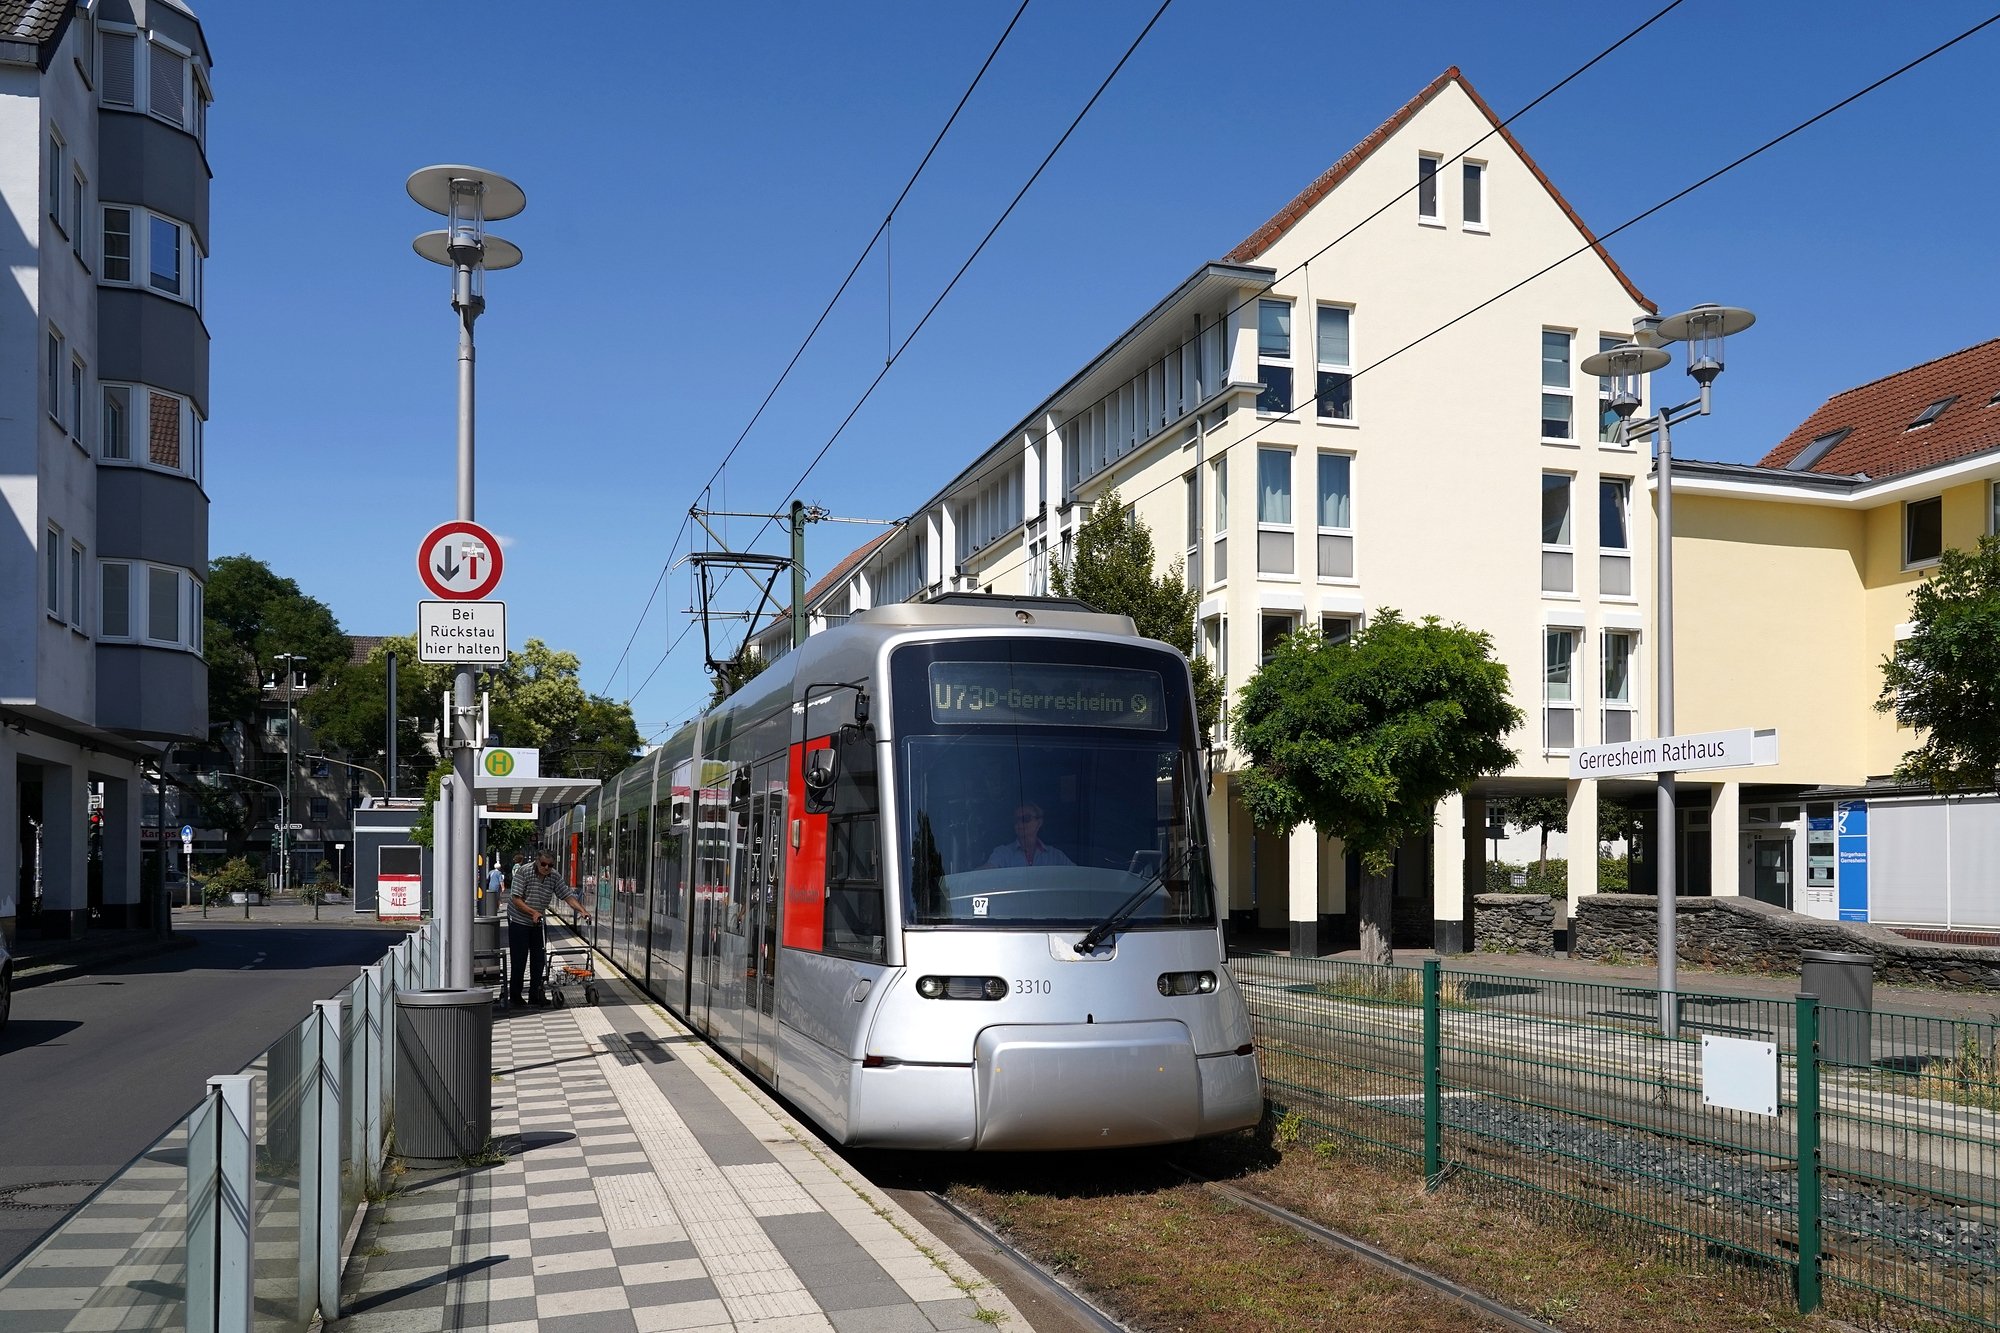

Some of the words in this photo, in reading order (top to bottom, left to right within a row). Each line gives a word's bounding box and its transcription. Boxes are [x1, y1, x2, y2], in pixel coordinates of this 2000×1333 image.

[452, 608, 474, 620] Bei
[430, 625, 495, 637] Rückstau
[425, 642, 453, 654] hier
[457, 642, 500, 654] halten
[935, 683, 983, 710] U73
[1579, 746, 1656, 770] Gerresheim
[1662, 740, 1725, 762] Rathaus
[391, 898, 406, 906] ALLE
[974, 899, 987, 909] 07
[1015, 979, 1051, 995] 3310
